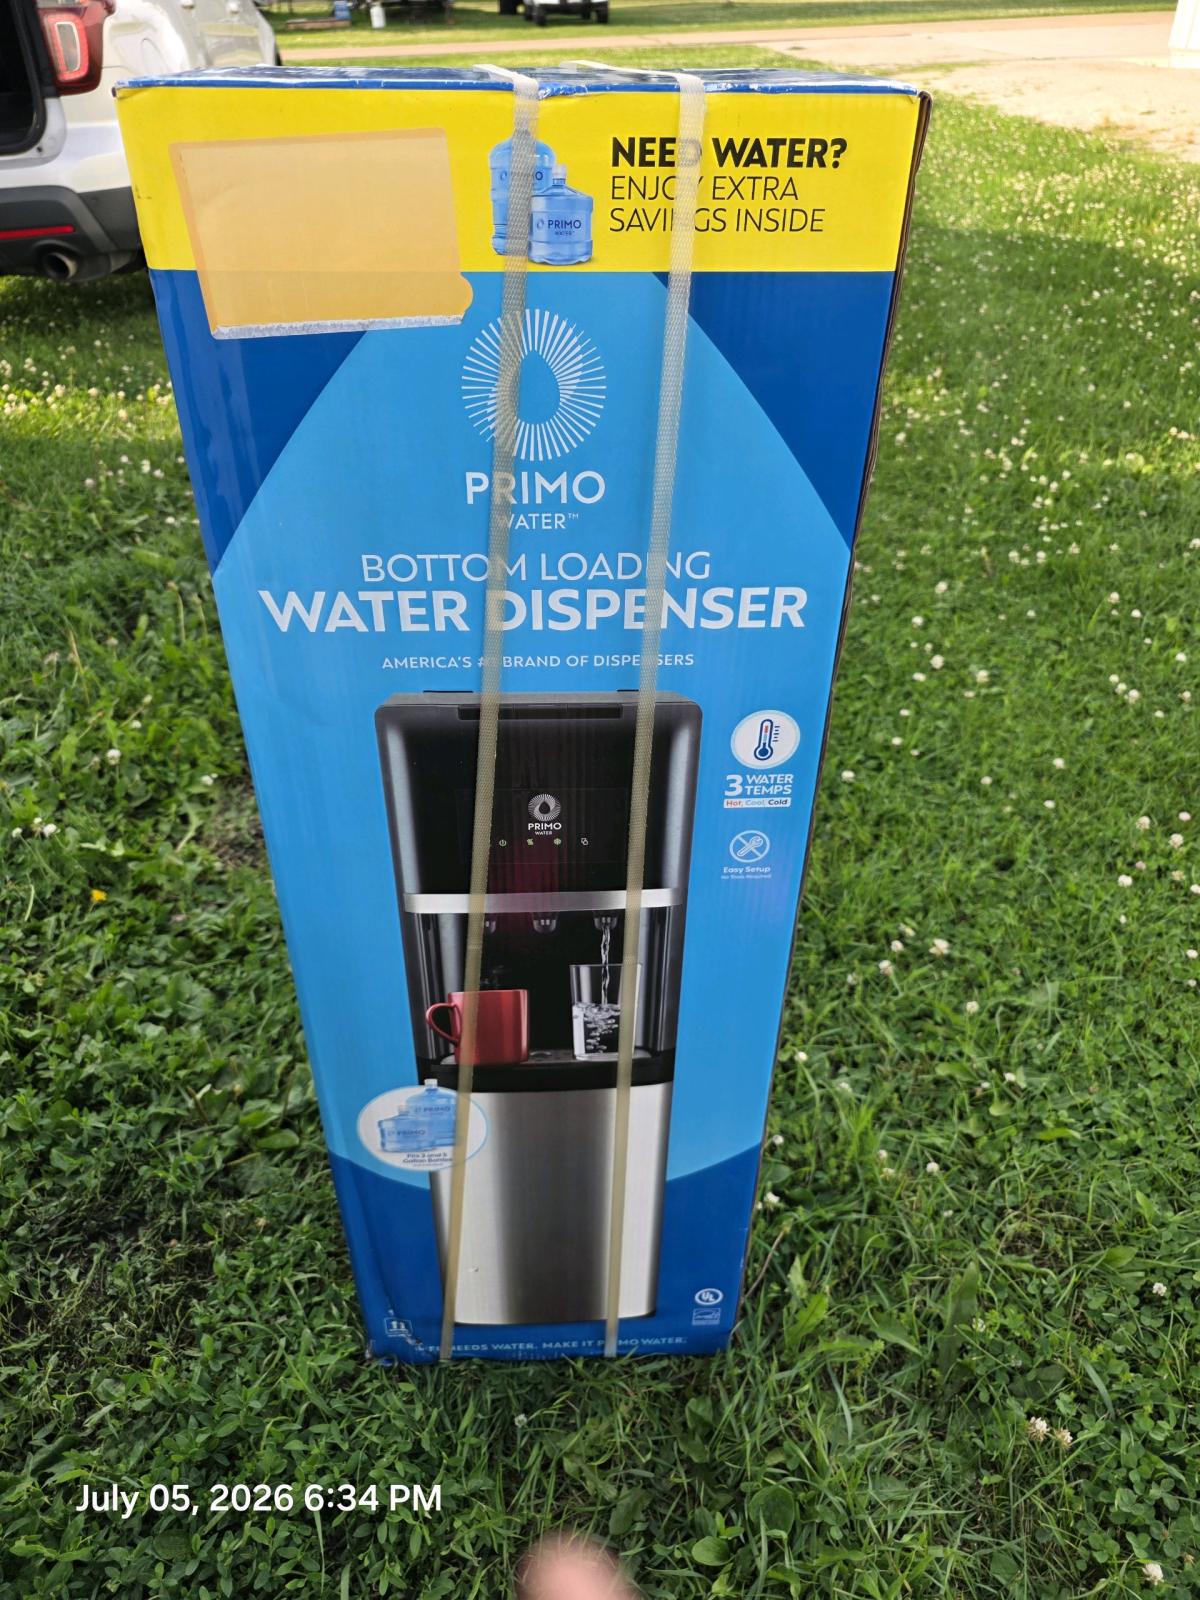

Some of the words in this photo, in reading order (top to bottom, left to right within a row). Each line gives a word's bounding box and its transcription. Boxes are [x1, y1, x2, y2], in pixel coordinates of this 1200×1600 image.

[712, 137, 847, 168] WATER?
[611, 175, 704, 200] ENJO
[712, 176, 799, 200] EXTRA
[547, 219, 582, 230] PRIMO
[610, 207, 726, 232] SAVIGS
[735, 208, 826, 232] INSIDE
[465, 470, 606, 505] PRIMO
[361, 553, 527, 583] BOTTOM
[257, 590, 471, 633] WATER
[485, 586, 809, 632] DISPENSER
[382, 656, 472, 669] AMERICA'S
[503, 656, 561, 668] BRAND
[566, 655, 589, 667] OF
[593, 654, 694, 667] DISPESERS
[723, 774, 744, 797] 3
[745, 773, 795, 785] WATER
[745, 784, 792, 796] TEMPS
[768, 798, 788, 806] Cold
[527, 822, 562, 831] PRIMO
[723, 866, 744, 875] Easy
[745, 865, 771, 874] Setup
[542, 1341, 579, 1349] MAKE
[596, 1338, 639, 1347] PMO
